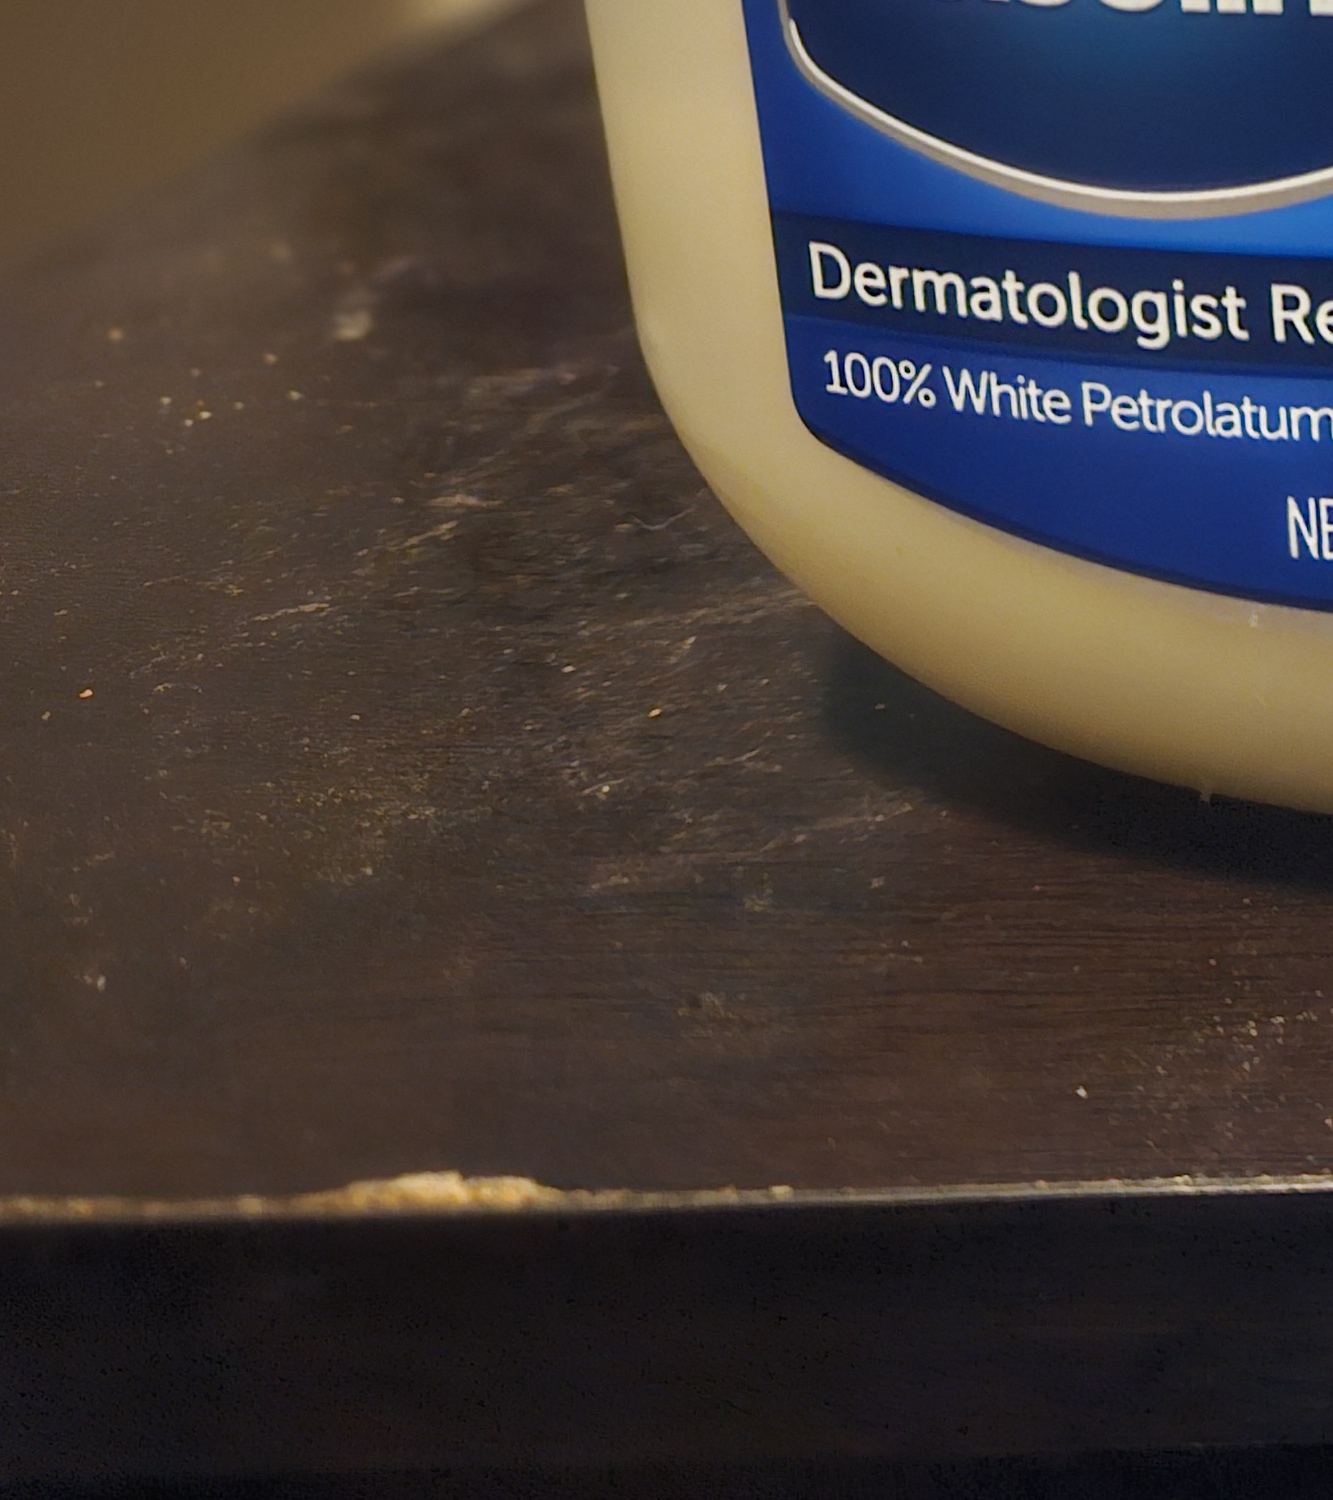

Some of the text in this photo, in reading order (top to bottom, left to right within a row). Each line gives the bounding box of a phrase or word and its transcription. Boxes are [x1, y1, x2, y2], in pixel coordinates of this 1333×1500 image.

[808, 240, 1250, 351] Dermatologist
[823, 349, 936, 409] 100%
[942, 365, 1072, 425] White
